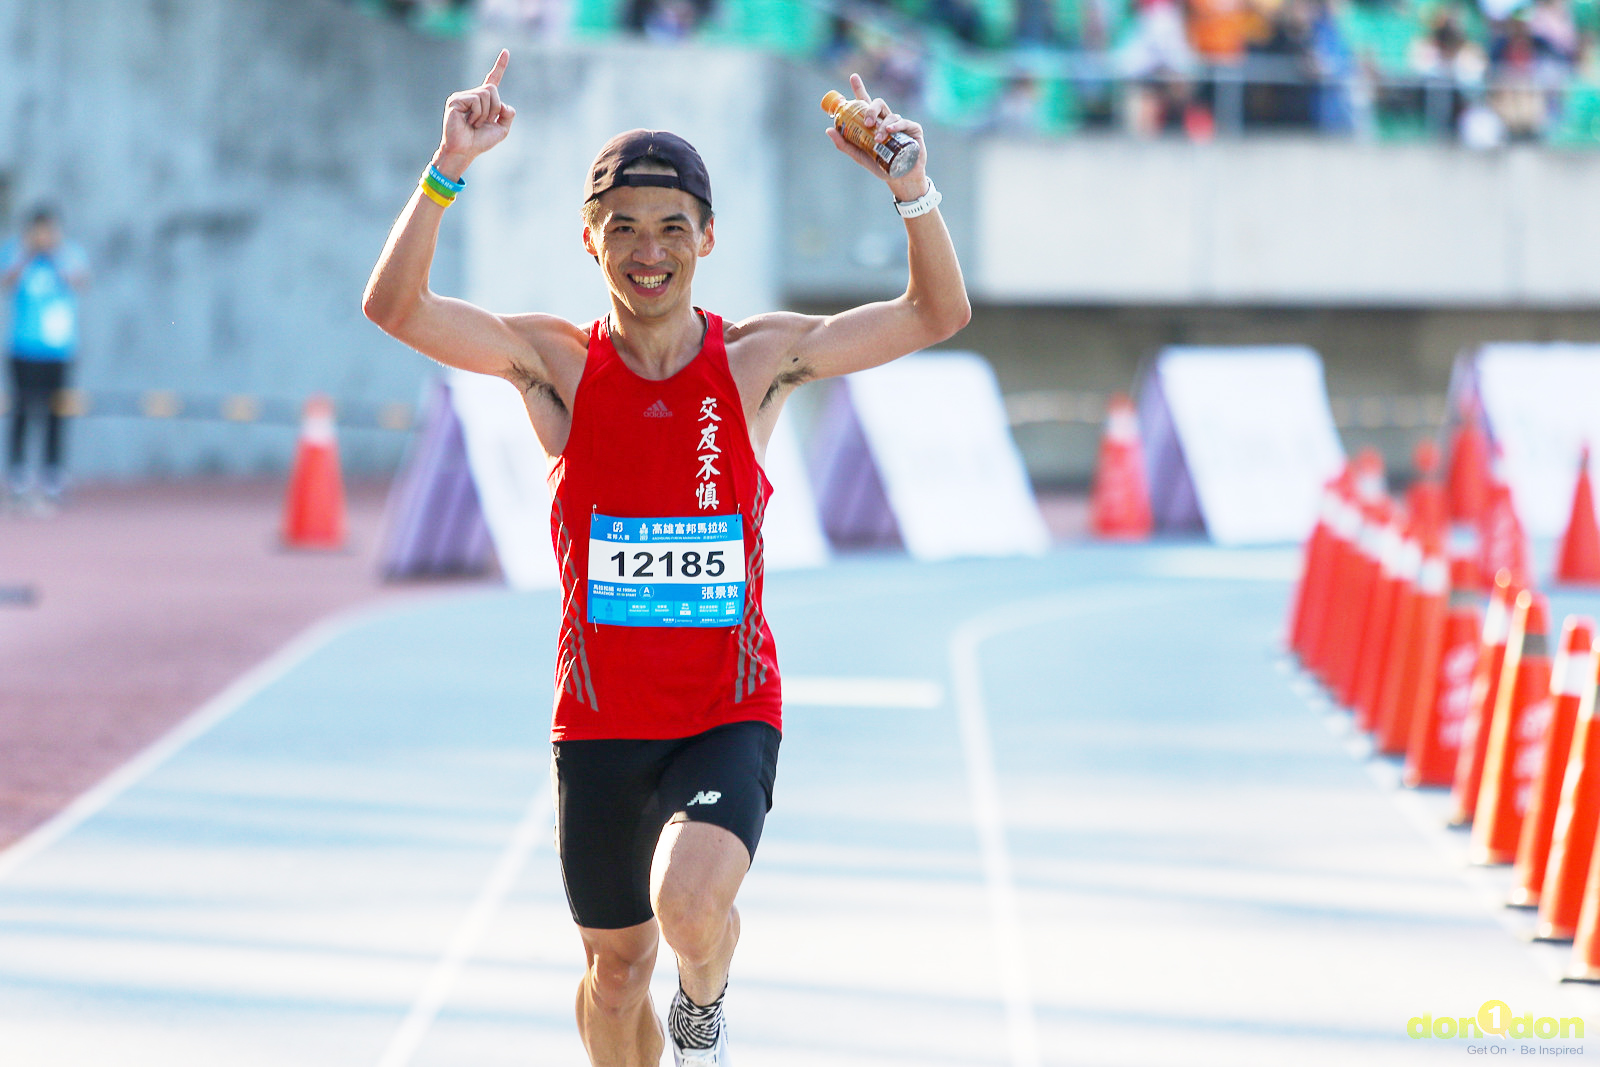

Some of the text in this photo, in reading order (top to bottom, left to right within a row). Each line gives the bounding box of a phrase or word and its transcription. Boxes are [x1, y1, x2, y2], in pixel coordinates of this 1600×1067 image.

[643, 410, 673, 418] adidas
[695, 396, 722, 510] 交友不慎
[652, 521, 728, 535] 高雄富邦馬拉松
[610, 550, 725, 578] 12185
[643, 586, 650, 594] A
[701, 585, 738, 600] 張景敦
[686, 790, 722, 806] NB
